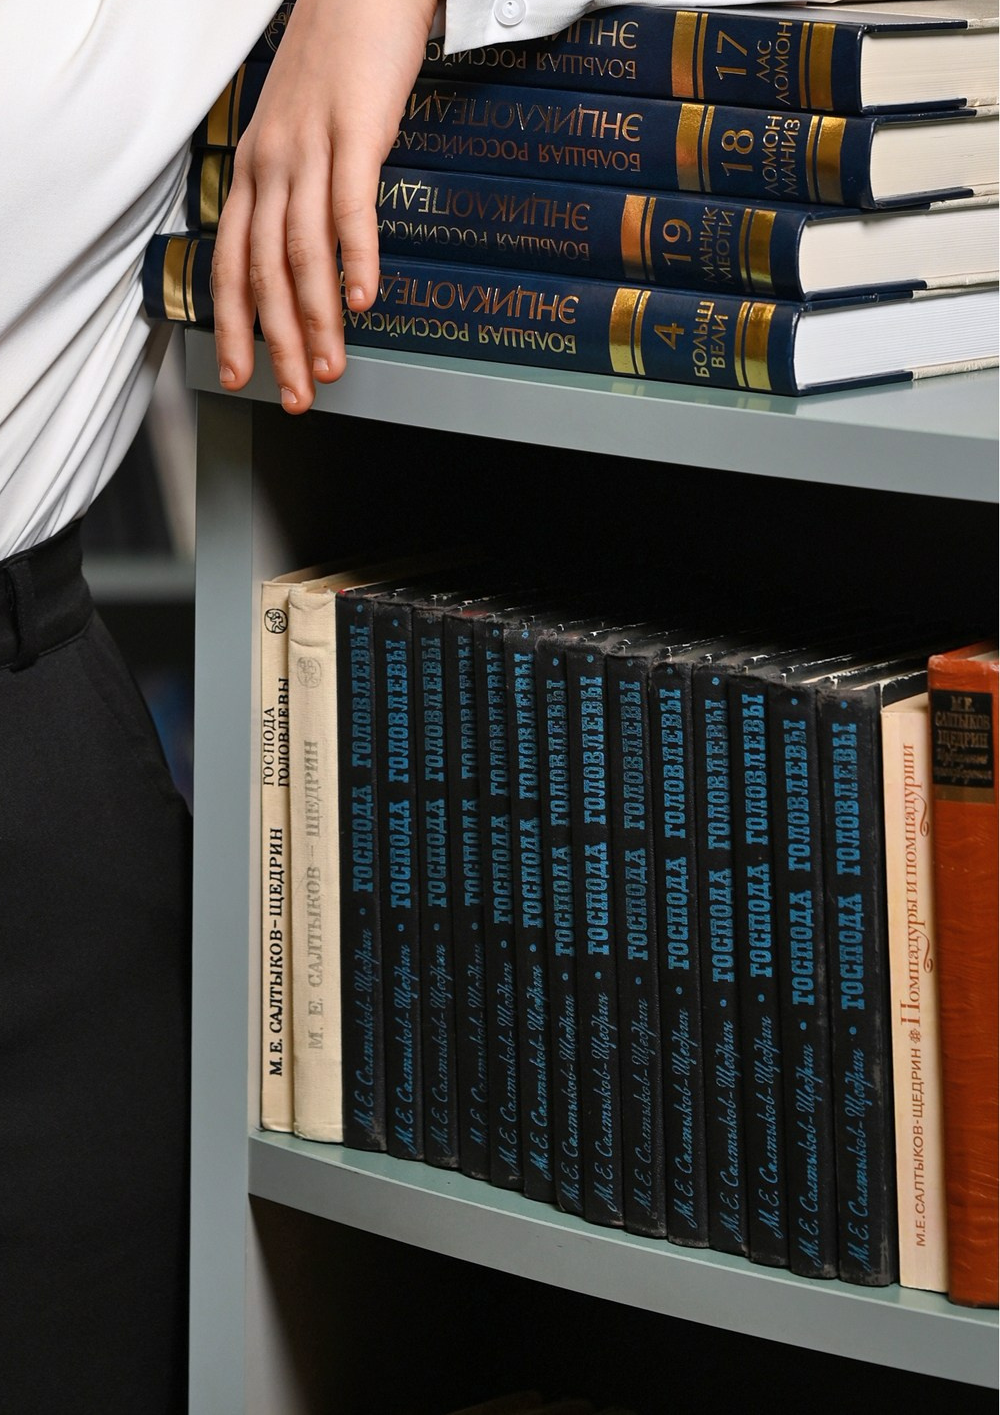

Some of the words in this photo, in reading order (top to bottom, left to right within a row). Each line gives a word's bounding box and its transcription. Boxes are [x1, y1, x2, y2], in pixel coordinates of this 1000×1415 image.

[424, 42, 527, 70] РОССИЙС
[536, 52, 637, 80] БОЛЬШАЯ
[715, 30, 748, 80] 17
[756, 40, 773, 83] ЛАС
[774, 21, 793, 106] ЛОМОН
[398, 90, 644, 142] ЭНЦИКЛОПЕДИ
[538, 144, 642, 172] БОЛЬШАЯ
[720, 129, 755, 176] 18
[762, 115, 783, 196] ЛОМОН
[780, 118, 801, 196] МАНИЗ
[378, 178, 592, 232] ЭНЦИКЛОПЕДИ
[378, 219, 488, 253] РОССИЙСКА
[496, 232, 591, 261] БОЛЬШАЯ
[662, 218, 693, 266] 19
[699, 206, 720, 283] МАНИК
[715, 209, 736, 284] МЕОТИ
[477, 324, 577, 354] БОЛЬШАЯ
[653, 322, 686, 350] 4
[690, 300, 715, 378] БОЛЬШ
[710, 313, 729, 368] ВЕЛИ
[263, 706, 275, 787] ГОСПОДА
[278, 678, 289, 787] ГОЛОВЛЕВЫ
[349, 625, 372, 767] ГОЛОВЛЕВЫ
[384, 639, 410, 783] ГОЛОВЛЕВЫ
[421, 638, 445, 782] ГОЛОВЛЕВЫ
[513, 652, 538, 799] ГОЛОВЛЕВЫ
[579, 675, 607, 825] ГОЛОВЛЕВЫ
[546, 680, 568, 825] ГОЛОВЛЕВЫ
[619, 681, 646, 830] ГОЛОВЛЕВЫ
[659, 687, 686, 839] ГОЛОВЛЕВЫ
[704, 699, 731, 849] ГОЛОВЛЕВЫ
[741, 692, 770, 846] ГОЛОВЛЕВЫ
[782, 719, 812, 872] ГОЛОВЛЕВЫ
[831, 721, 862, 876] ГОЛОВЛЕВЫ
[351, 785, 374, 892] ГОСПОДА
[388, 798, 412, 908] ГОСПОДА
[425, 797, 448, 907] ГОСПОДА
[903, 743, 930, 879] помпадурши
[519, 818, 544, 927] ГОСПОДА
[552, 846, 574, 955] ГОСПОДА
[584, 841, 610, 954] ГОСПОДА
[624, 848, 648, 961] ГОСПОДА
[664, 857, 691, 969] ГОСПОДА
[708, 868, 735, 983] ГОСПОДА
[746, 862, 774, 977] ГОСПОДА
[905, 880, 918, 895] и
[268, 828, 285, 1033] САЛТЫКОВ-ЩЕДРИН
[789, 889, 816, 1005] ГОСПОДА
[837, 892, 866, 1009] ГОСПОДА
[899, 897, 934, 1027] Помпадуры
[355, 928, 376, 1085] Салтыков-Щедрин
[392, 944, 419, 1102] Салтыков-Щедрин
[591, 994, 616, 1156] Салтыков-Щедрин
[671, 1011, 696, 1173] Салтыков-Щедрин
[715, 1020, 740, 1186] Салтыков-Щедрин
[754, 1016, 780, 1183] Салтыков-Щедрин
[795, 1045, 824, 1212] Салтыков-Щедрин
[845, 1049, 872, 1216] Салтыков-Щедрин
